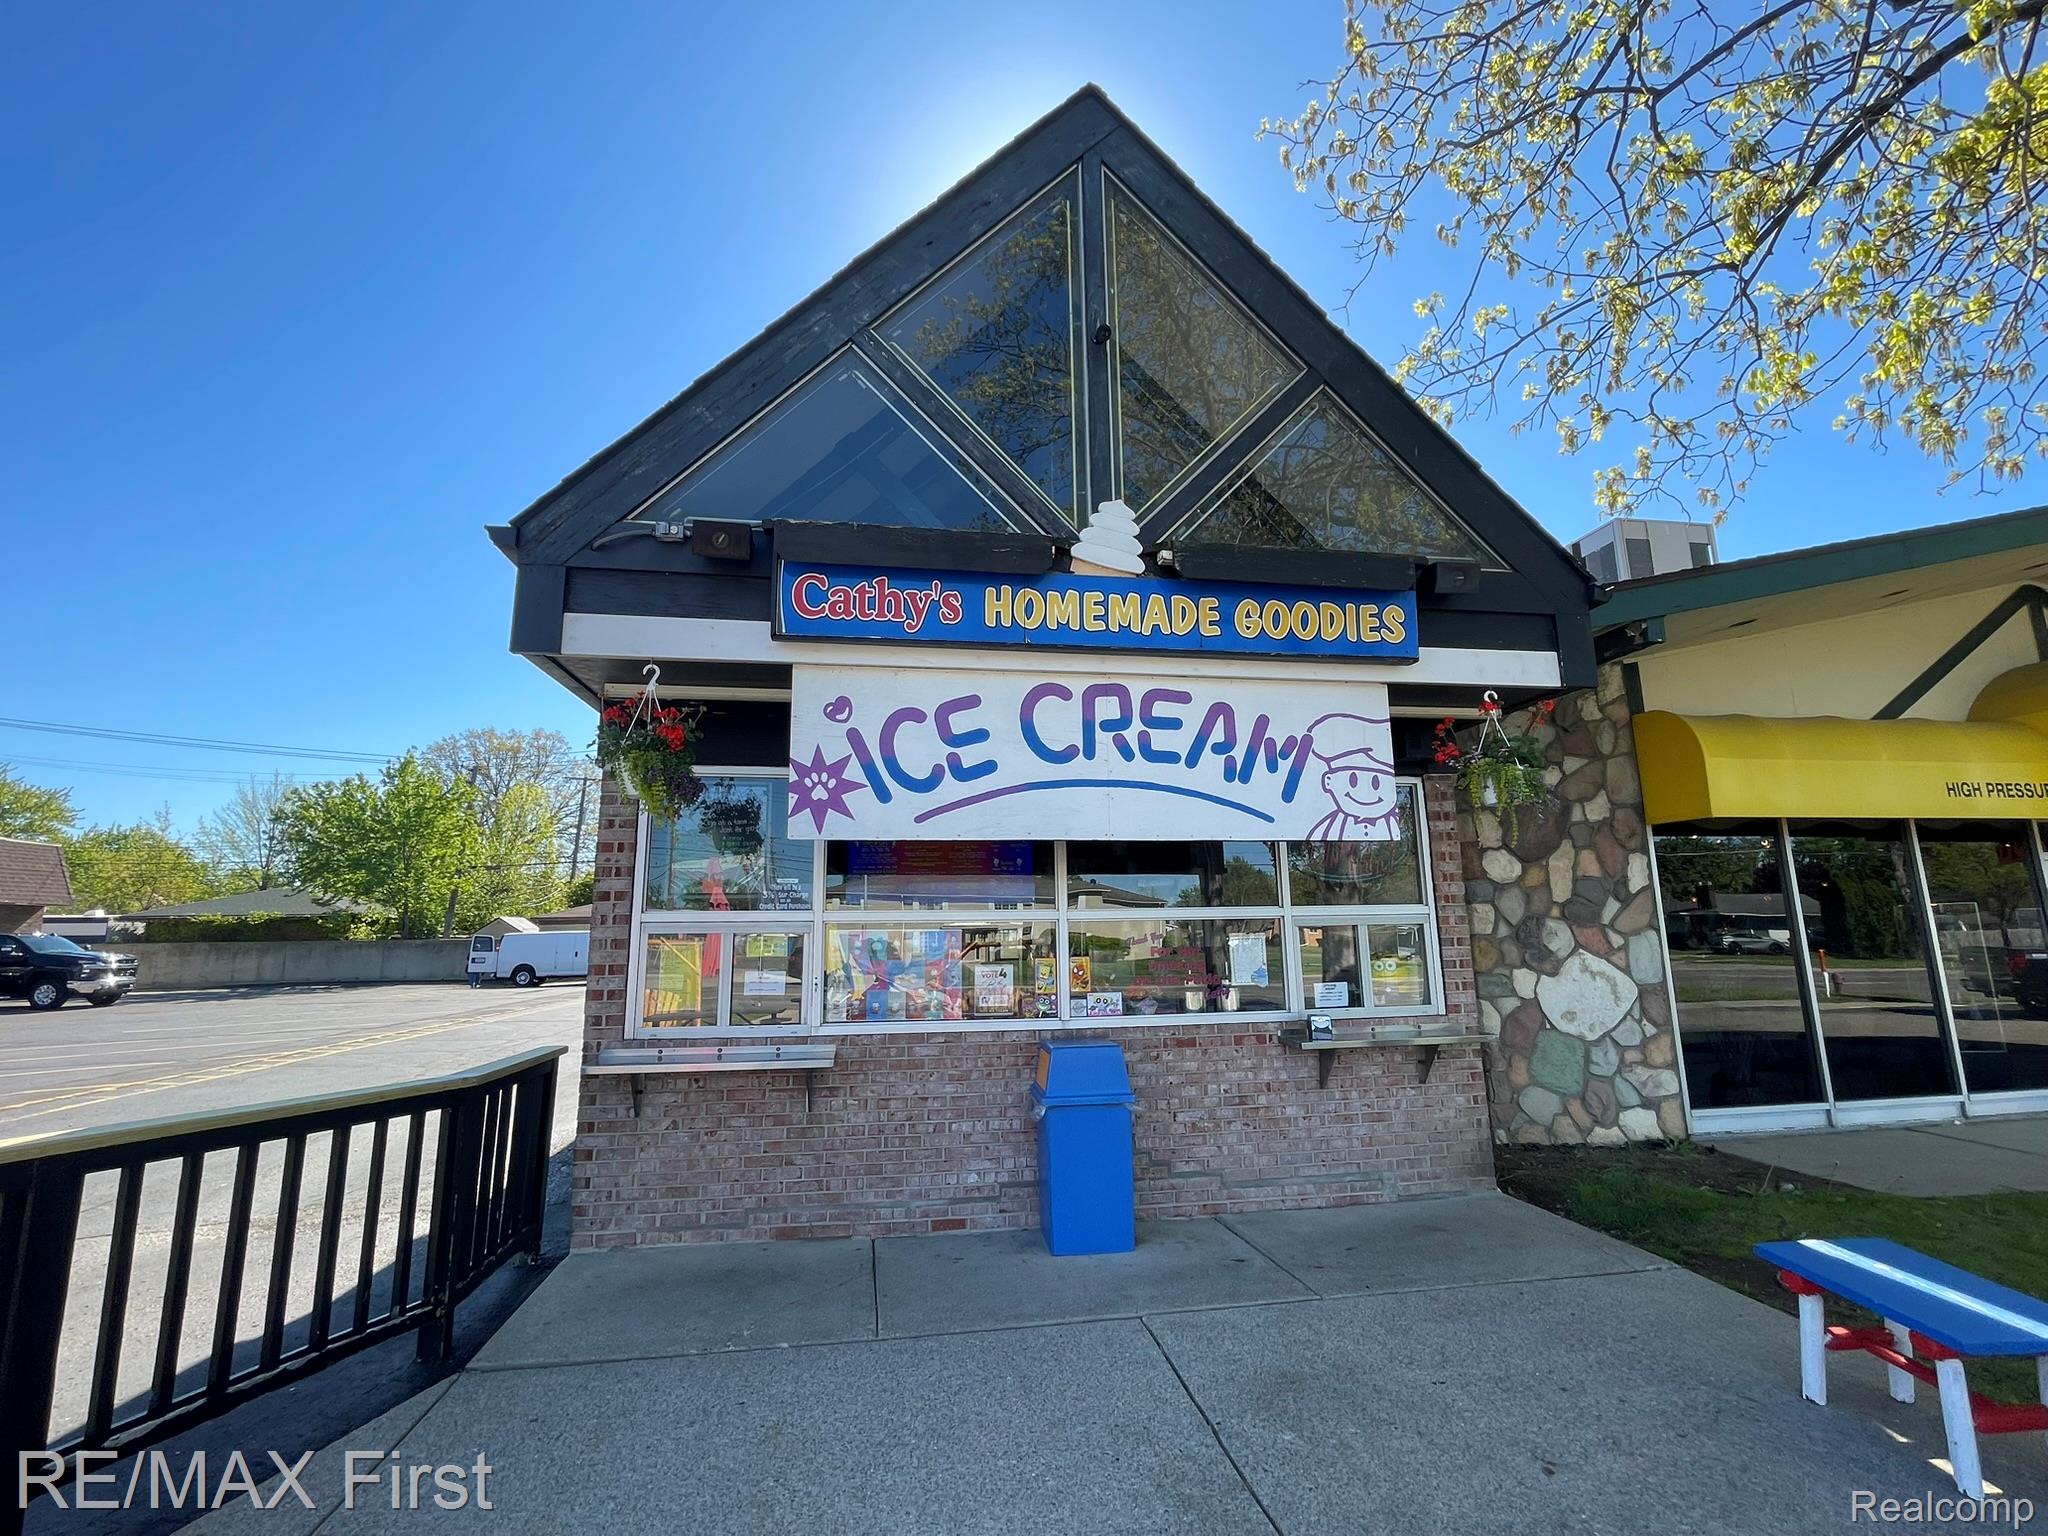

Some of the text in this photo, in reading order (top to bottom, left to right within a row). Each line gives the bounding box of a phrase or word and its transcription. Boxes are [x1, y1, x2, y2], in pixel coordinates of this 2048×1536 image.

[791, 572, 1406, 644] Cathy's HOMEMADE GOODIES
[1019, 682, 1314, 804] CREAM
[1945, 781, 1983, 798] HIGH
